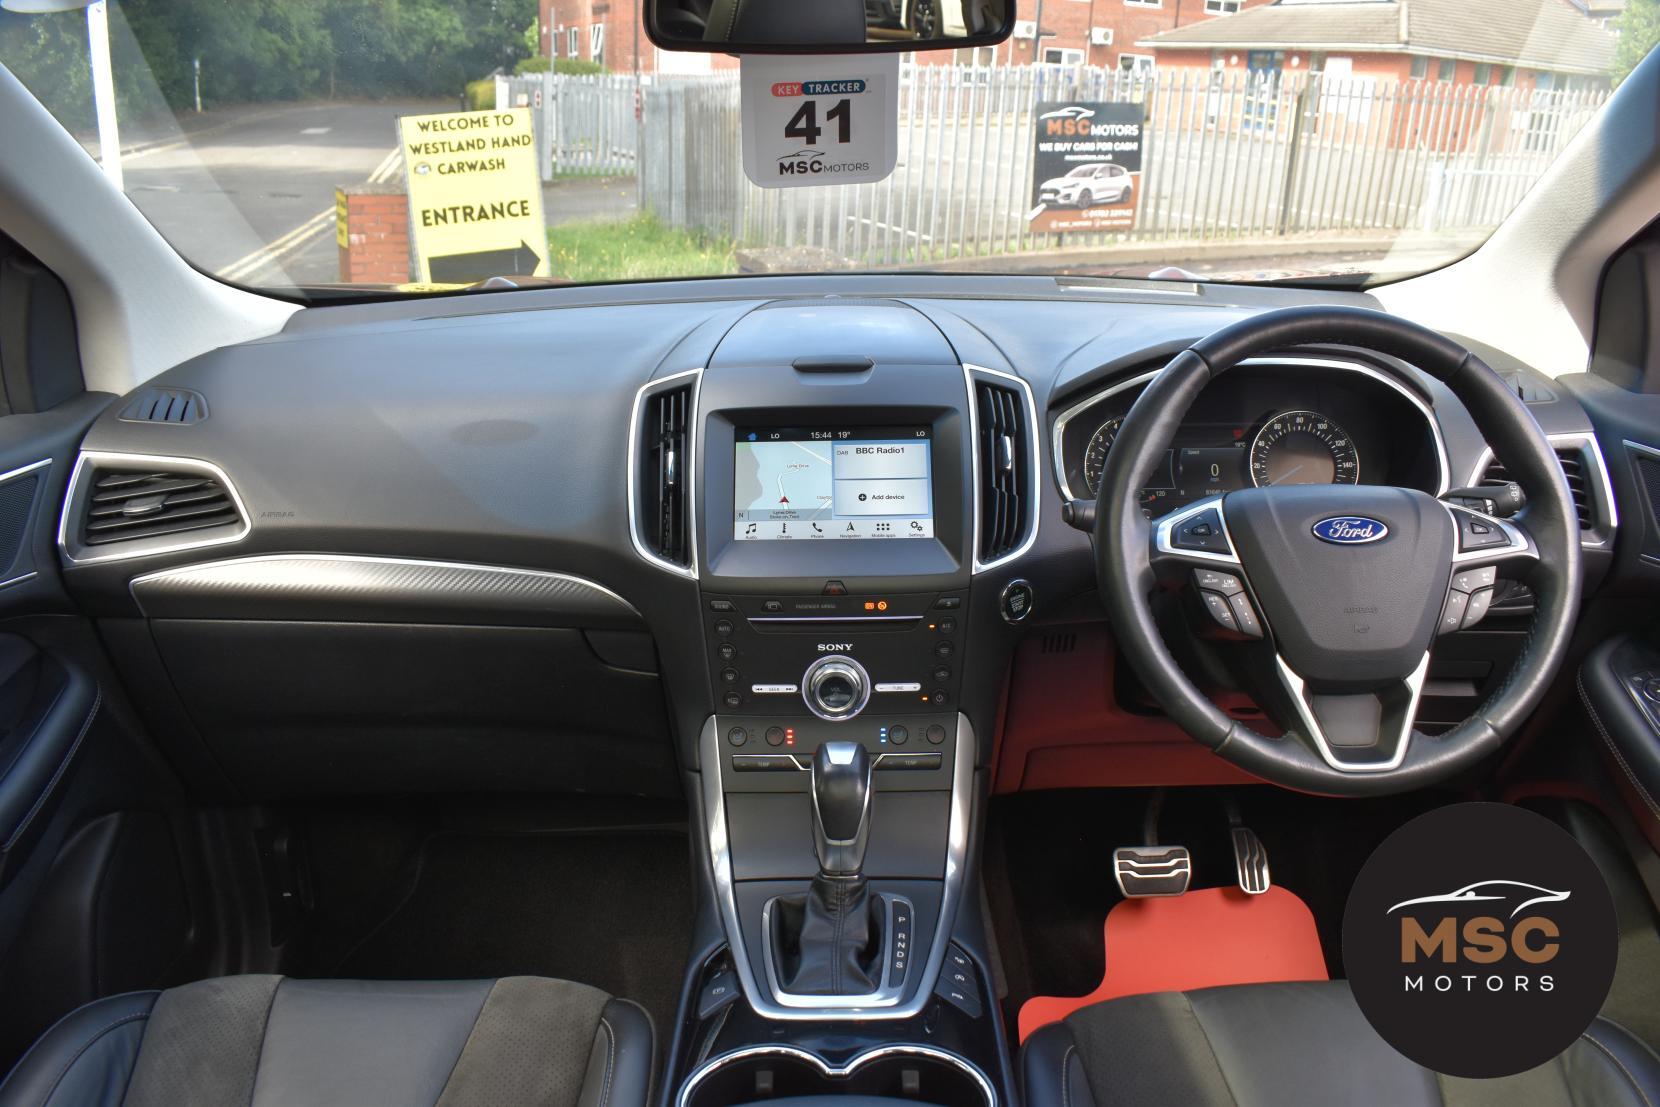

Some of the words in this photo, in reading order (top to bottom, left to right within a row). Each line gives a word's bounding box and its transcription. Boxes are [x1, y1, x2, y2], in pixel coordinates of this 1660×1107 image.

[778, 84, 799, 95] KEY
[808, 82, 860, 94] TRACKER
[417, 116, 489, 132] WELCOME
[494, 114, 514, 127] TO
[784, 98, 851, 145] 41
[1047, 118, 1091, 136] MSC
[1091, 124, 1139, 136] MOTORS
[409, 138, 486, 155] WESTLAND
[491, 134, 531, 149] HAND
[1039, 142, 1053, 152] WE
[1054, 142, 1073, 152] BUY
[1073, 142, 1096, 152] CARS
[1096, 142, 1113, 152] FOR
[437, 158, 506, 175] CARWASH
[779, 160, 823, 175] MSC
[823, 162, 870, 173] MOTORS
[421, 200, 530, 227] ENTRANCE
[811, 431, 832, 439] 15:44
[876, 446, 905, 454] Radio1
[1210, 463, 1219, 477] 0
[1328, 520, 1374, 538] Ford
[817, 643, 854, 651] SONY
